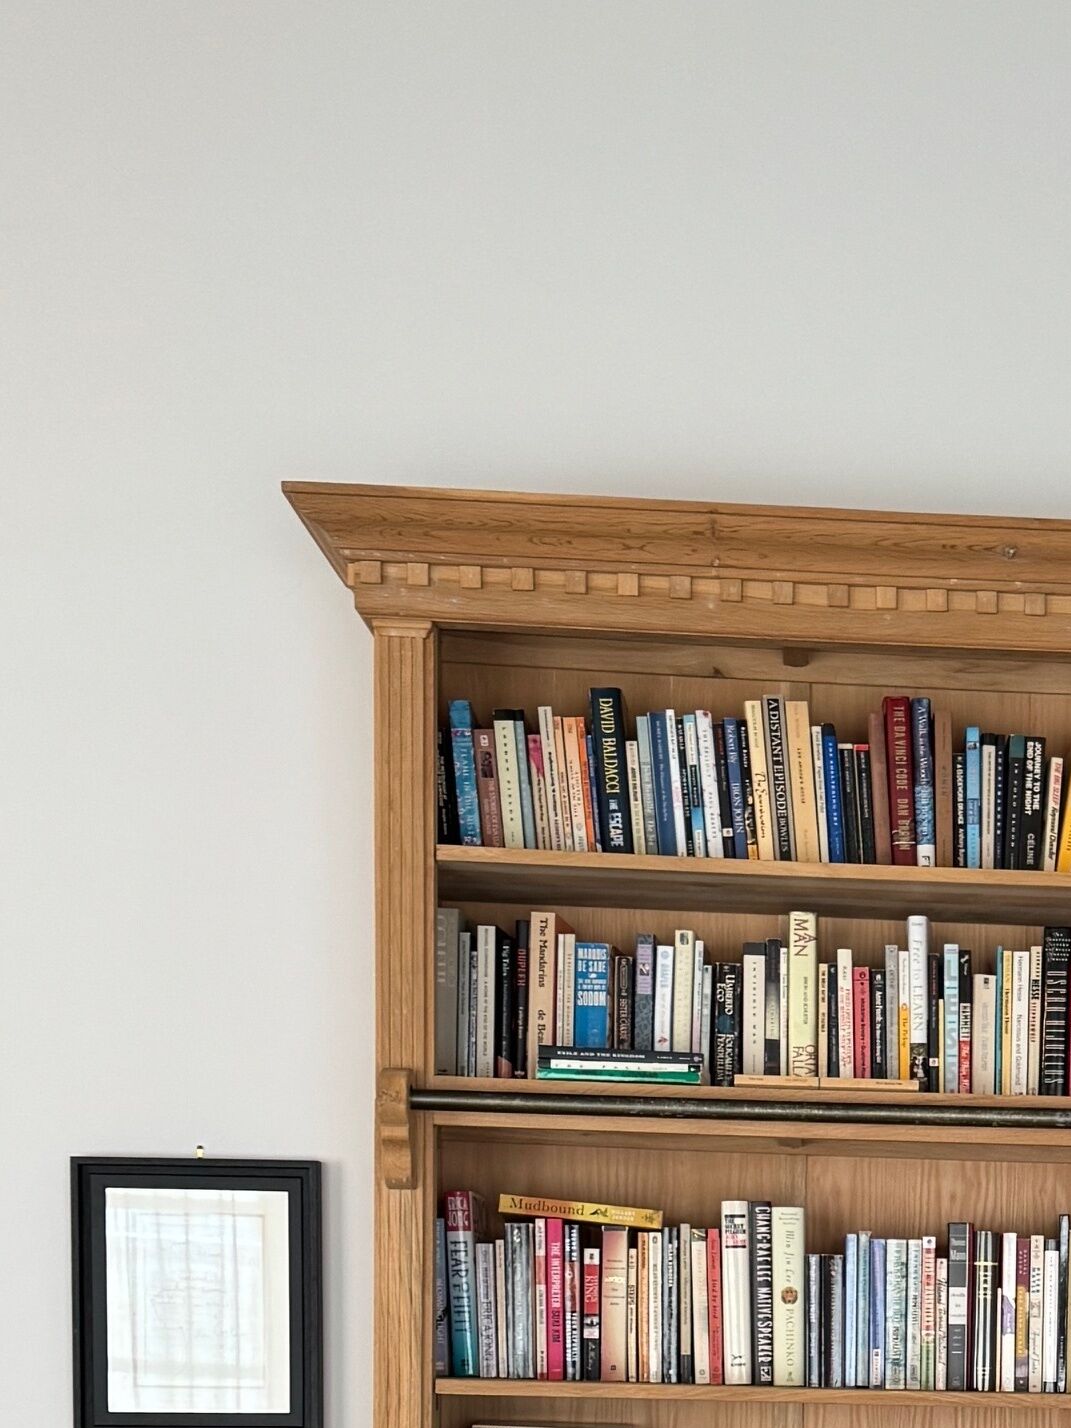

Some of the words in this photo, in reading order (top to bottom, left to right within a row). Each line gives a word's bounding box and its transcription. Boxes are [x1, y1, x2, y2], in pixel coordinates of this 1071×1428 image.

[599, 698, 615, 733] DAVID
[769, 700, 778, 708] A
[893, 707, 905, 721] THE
[770, 711, 781, 762] DISTANT
[894, 726, 905, 737] DA
[895, 740, 906, 764] VINCI
[1034, 741, 1042, 779] JOURNEY
[602, 738, 619, 794] BALDACCI
[897, 768, 907, 790] CODE
[774, 765, 787, 816] EPISODE
[1025, 773, 1033, 788] THE
[1033, 782, 1039, 791] TO
[898, 798, 908, 815] DAN
[1024, 791, 1032, 815] NIGHT
[609, 813, 623, 846] ESCAPE
[539, 918, 548, 937] The
[539, 940, 548, 987] Mandarins
[717, 983, 725, 1002] ECO
[726, 975, 735, 1015] UMBERTO
[1031, 979, 1039, 1000] HESSE
[912, 985, 923, 1031] LEARN
[509, 1198, 585, 1216] Mudbound
[450, 1241, 468, 1277] FEAR
[551, 1242, 560, 1255] THE
[552, 1258, 560, 1307] INTERPRETER
[757, 1266, 770, 1281] LEE
[586, 1275, 594, 1303] KING
[757, 1287, 770, 1319] NATIVE
[757, 1321, 772, 1363] SPEAKER
[786, 1309, 794, 1367] PACHINKO
